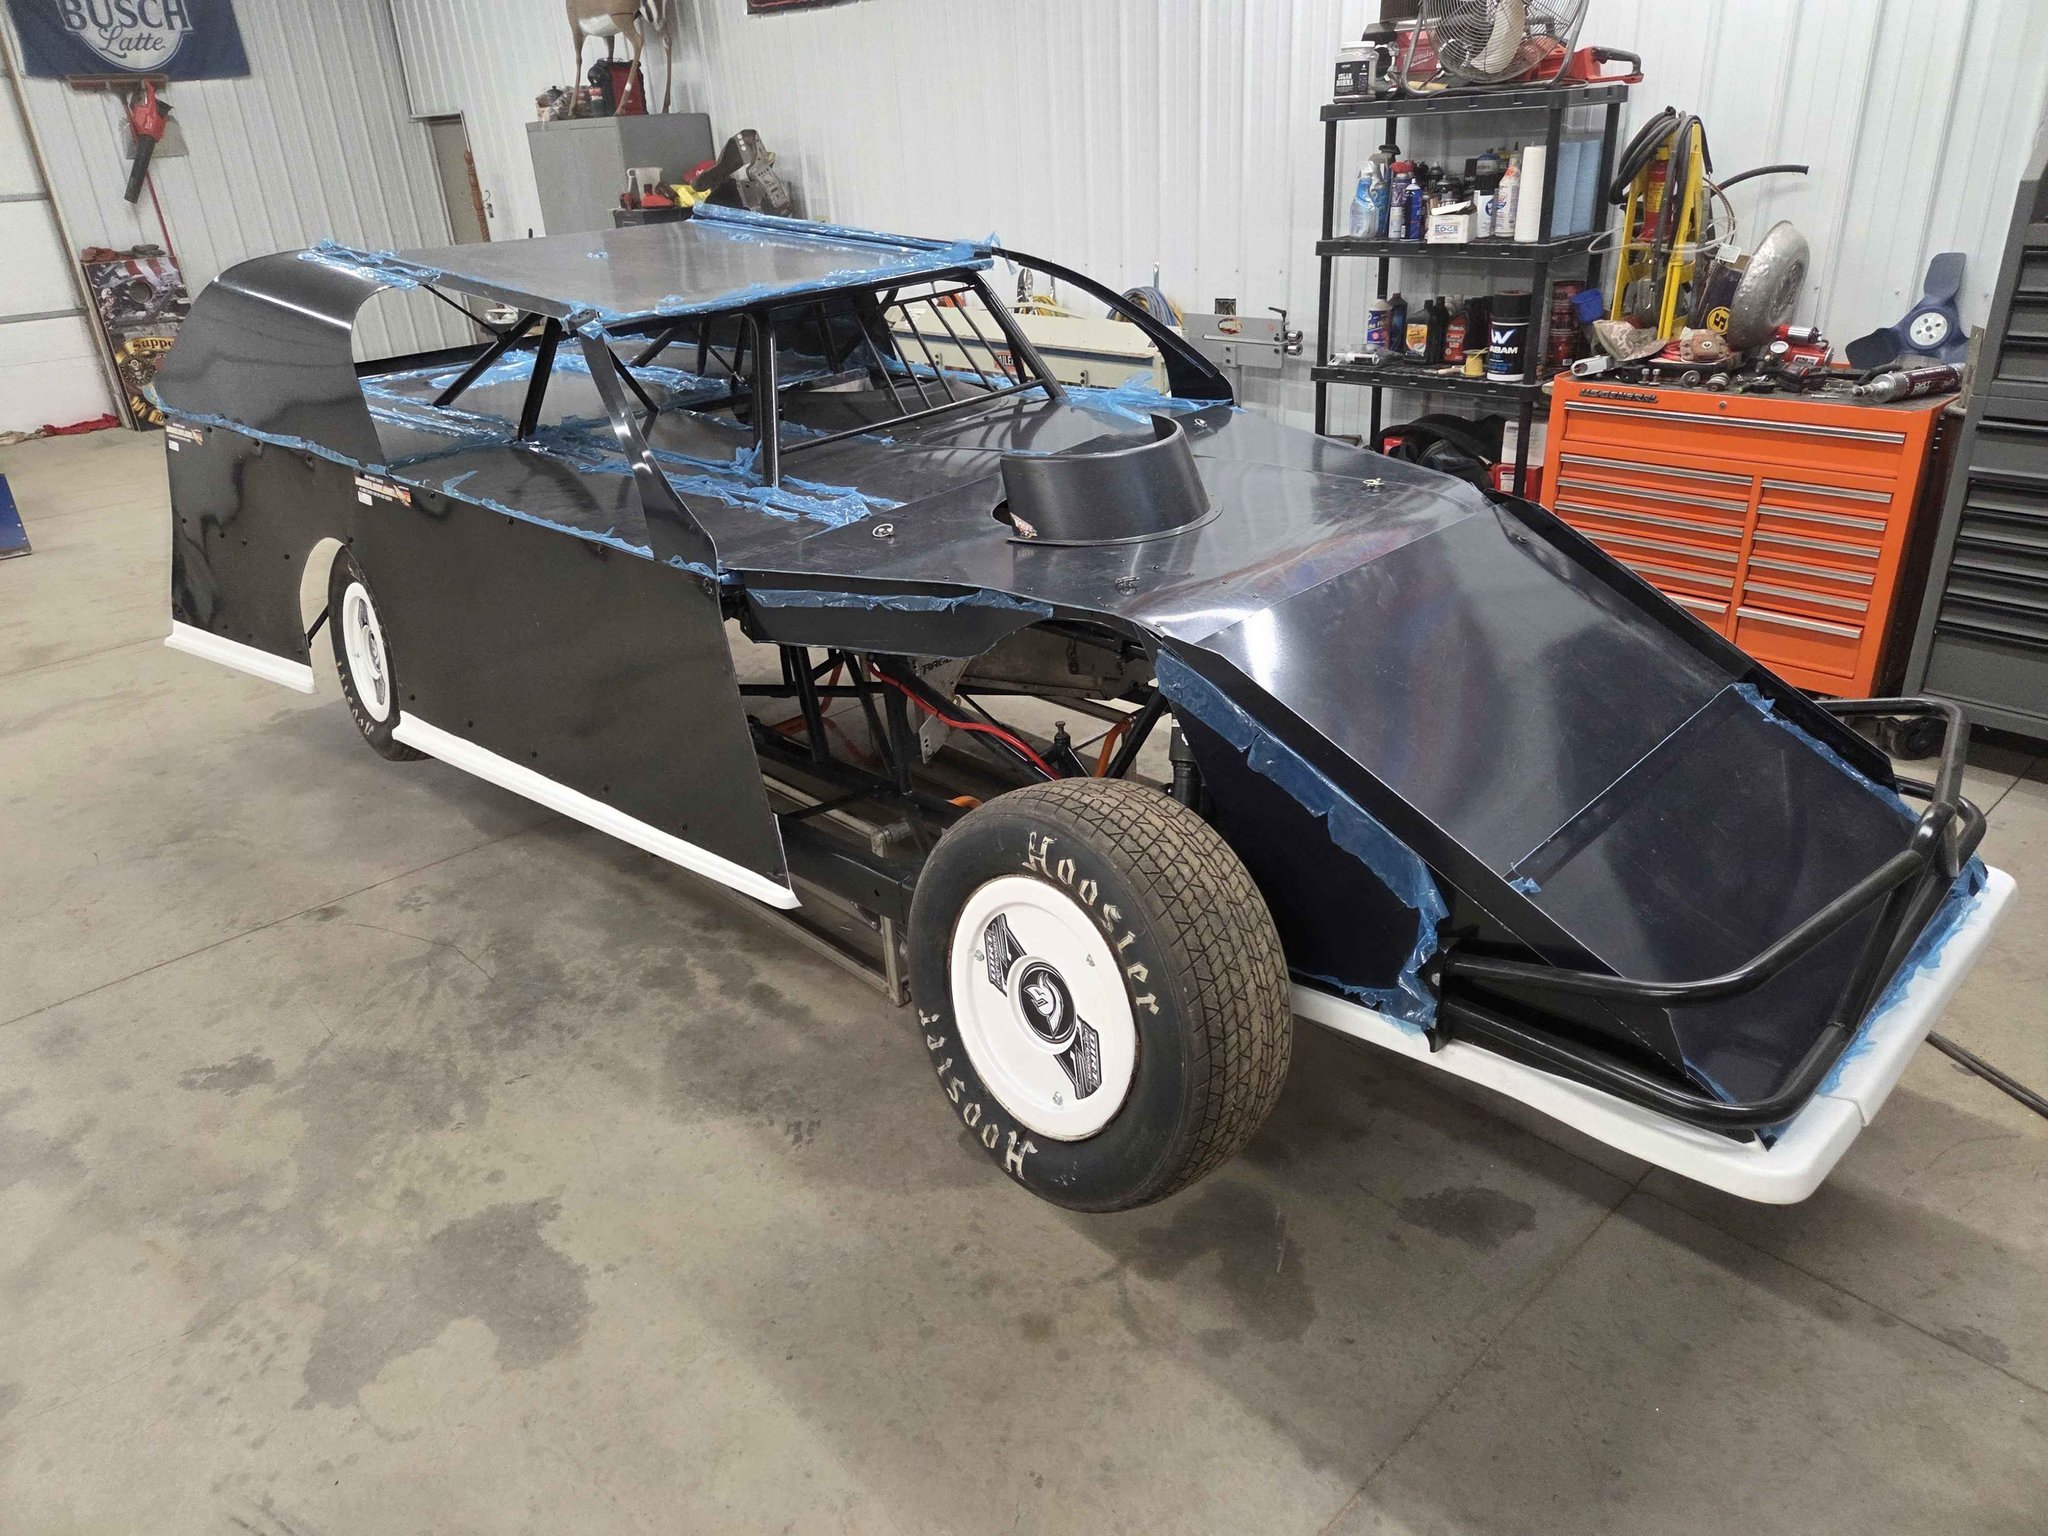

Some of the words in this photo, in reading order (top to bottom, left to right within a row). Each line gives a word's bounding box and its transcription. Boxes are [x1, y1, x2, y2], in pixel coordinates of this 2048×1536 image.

[59, 0, 188, 30] BUSCH
[97, 25, 167, 58] Latte
[1022, 829, 1160, 1016] Hoosier
[918, 1008, 1038, 1181] Hoosier
